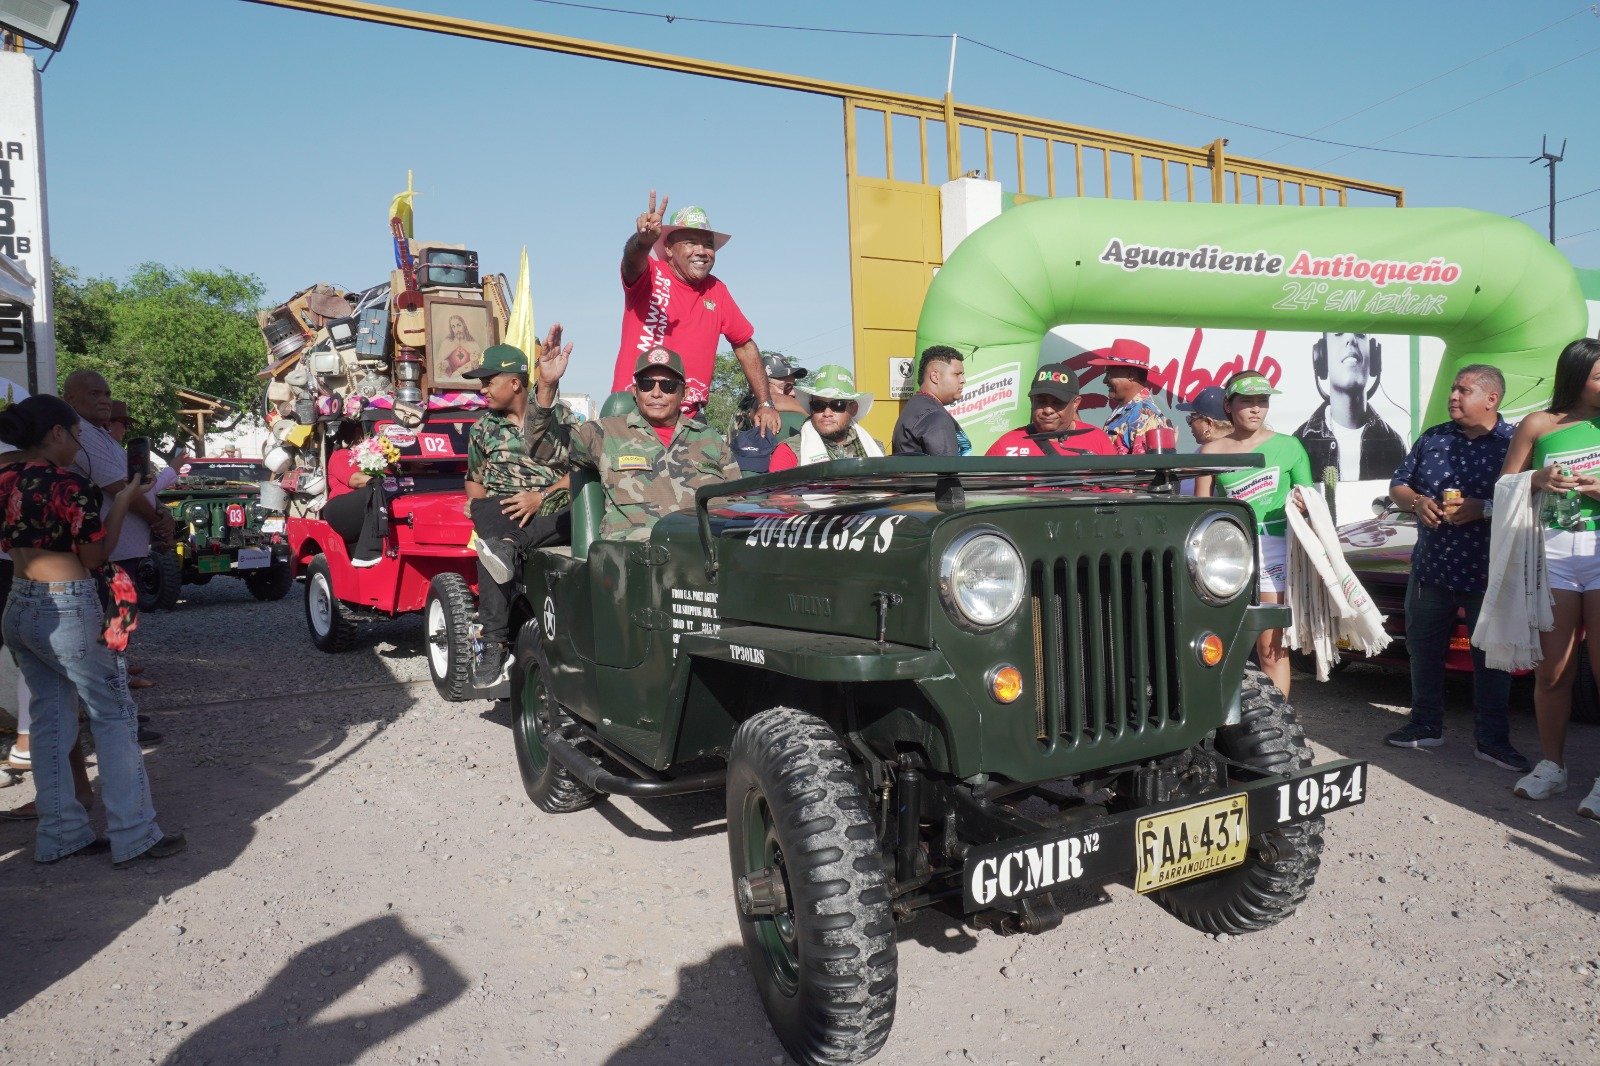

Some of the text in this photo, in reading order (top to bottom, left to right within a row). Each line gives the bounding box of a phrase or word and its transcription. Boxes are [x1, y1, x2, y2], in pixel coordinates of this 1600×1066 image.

[1100, 239, 1459, 286] Aguardiente Antioqueño
[1324, 289, 1365, 312] SIN
[1038, 371, 1069, 384] DAGO
[948, 388, 1013, 416] ntioqueño
[424, 437, 447, 453] 02
[1231, 474, 1273, 496] Aguardiente
[230, 509, 242, 523] 03
[873, 514, 908, 554] S
[1277, 765, 1363, 823] 1954
[1200, 807, 1244, 856] 437
[971, 837, 1084, 905] GCMR
[1159, 853, 1227, 882] BARRANQUILLA
